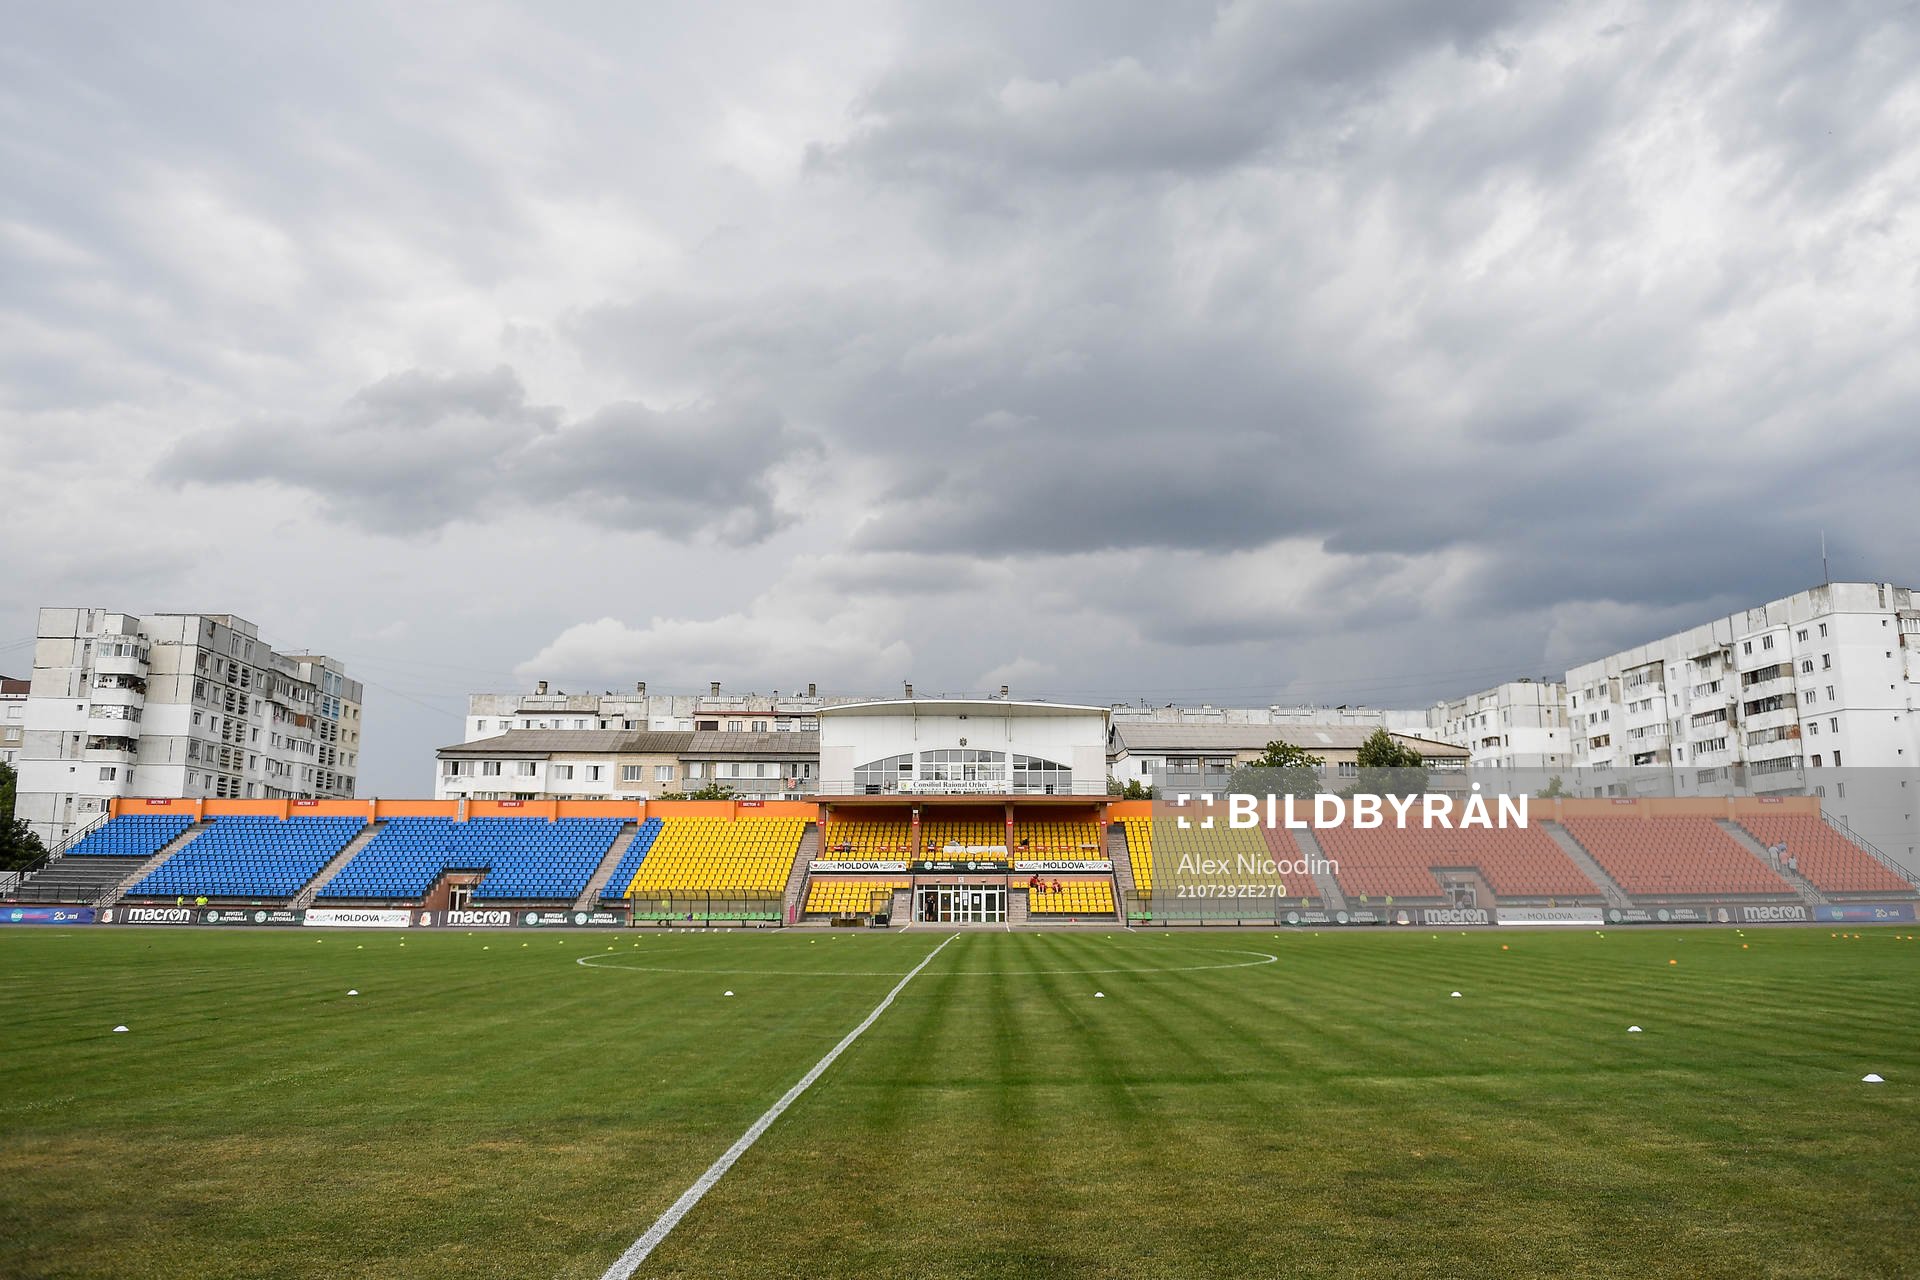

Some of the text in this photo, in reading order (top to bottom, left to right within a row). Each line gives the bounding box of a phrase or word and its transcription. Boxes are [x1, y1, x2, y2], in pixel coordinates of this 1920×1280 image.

[837, 862, 879, 870] MOLDOVA
[128, 908, 191, 921] macron
[447, 911, 511, 923] macron
[1424, 909, 1488, 922] macron
[1528, 912, 1573, 920] MOLDOVA
[1743, 906, 1806, 919] macron
